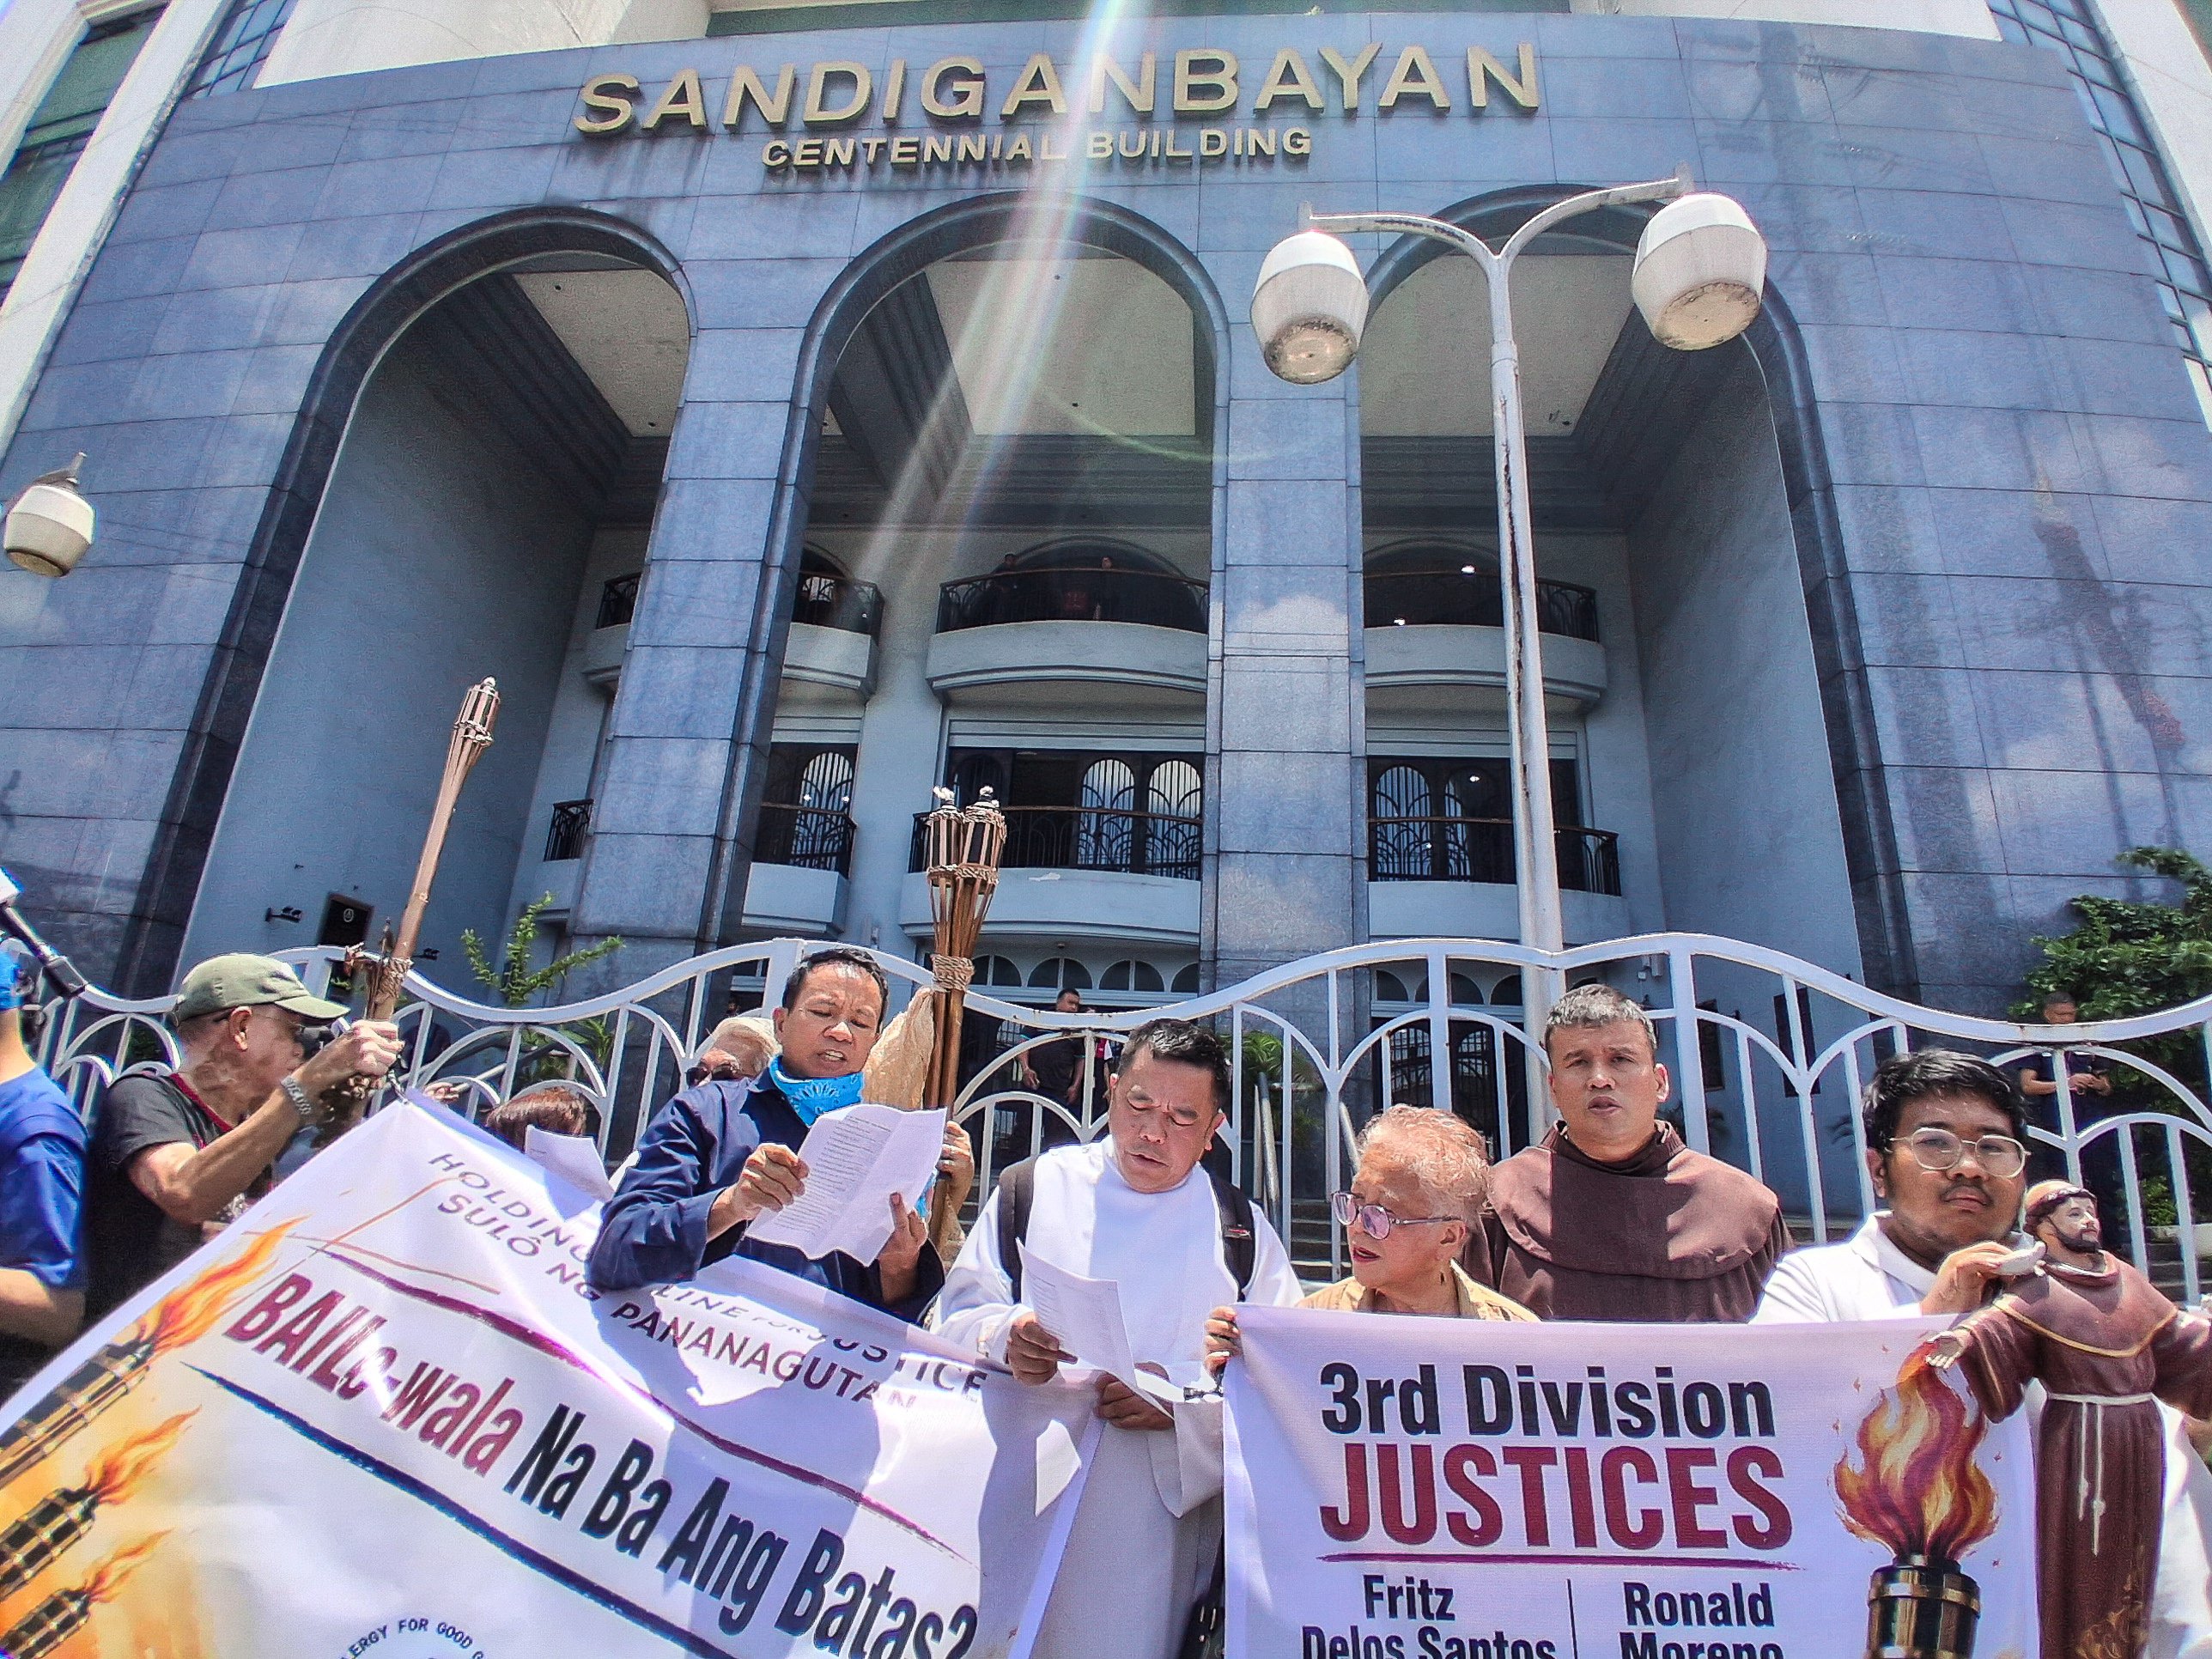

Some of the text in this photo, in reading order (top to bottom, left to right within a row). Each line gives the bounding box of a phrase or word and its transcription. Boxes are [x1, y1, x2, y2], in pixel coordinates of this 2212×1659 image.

[572, 41, 1540, 134] SANDIGANBAYAN
[761, 126, 1311, 167] CENTENNIAL BUILDING
[545, 1262, 601, 1301] NG
[610, 1302, 916, 1408] PANANAGUTAN
[1320, 1362, 1776, 1438] 3rd Division
[1320, 1443, 1792, 1550] JUSTICES
[502, 1403, 596, 1521] Na
[579, 1438, 672, 1559] Ba
[655, 1476, 789, 1635] Ang
[774, 1528, 977, 1659] Batas?
[1363, 1574, 1455, 1620] Fritz
[1623, 1581, 1775, 1627] Ronald
[340, 1618, 473, 1659] ERGY FOR GOOD
[1302, 1625, 1556, 1659] Delos Santos
